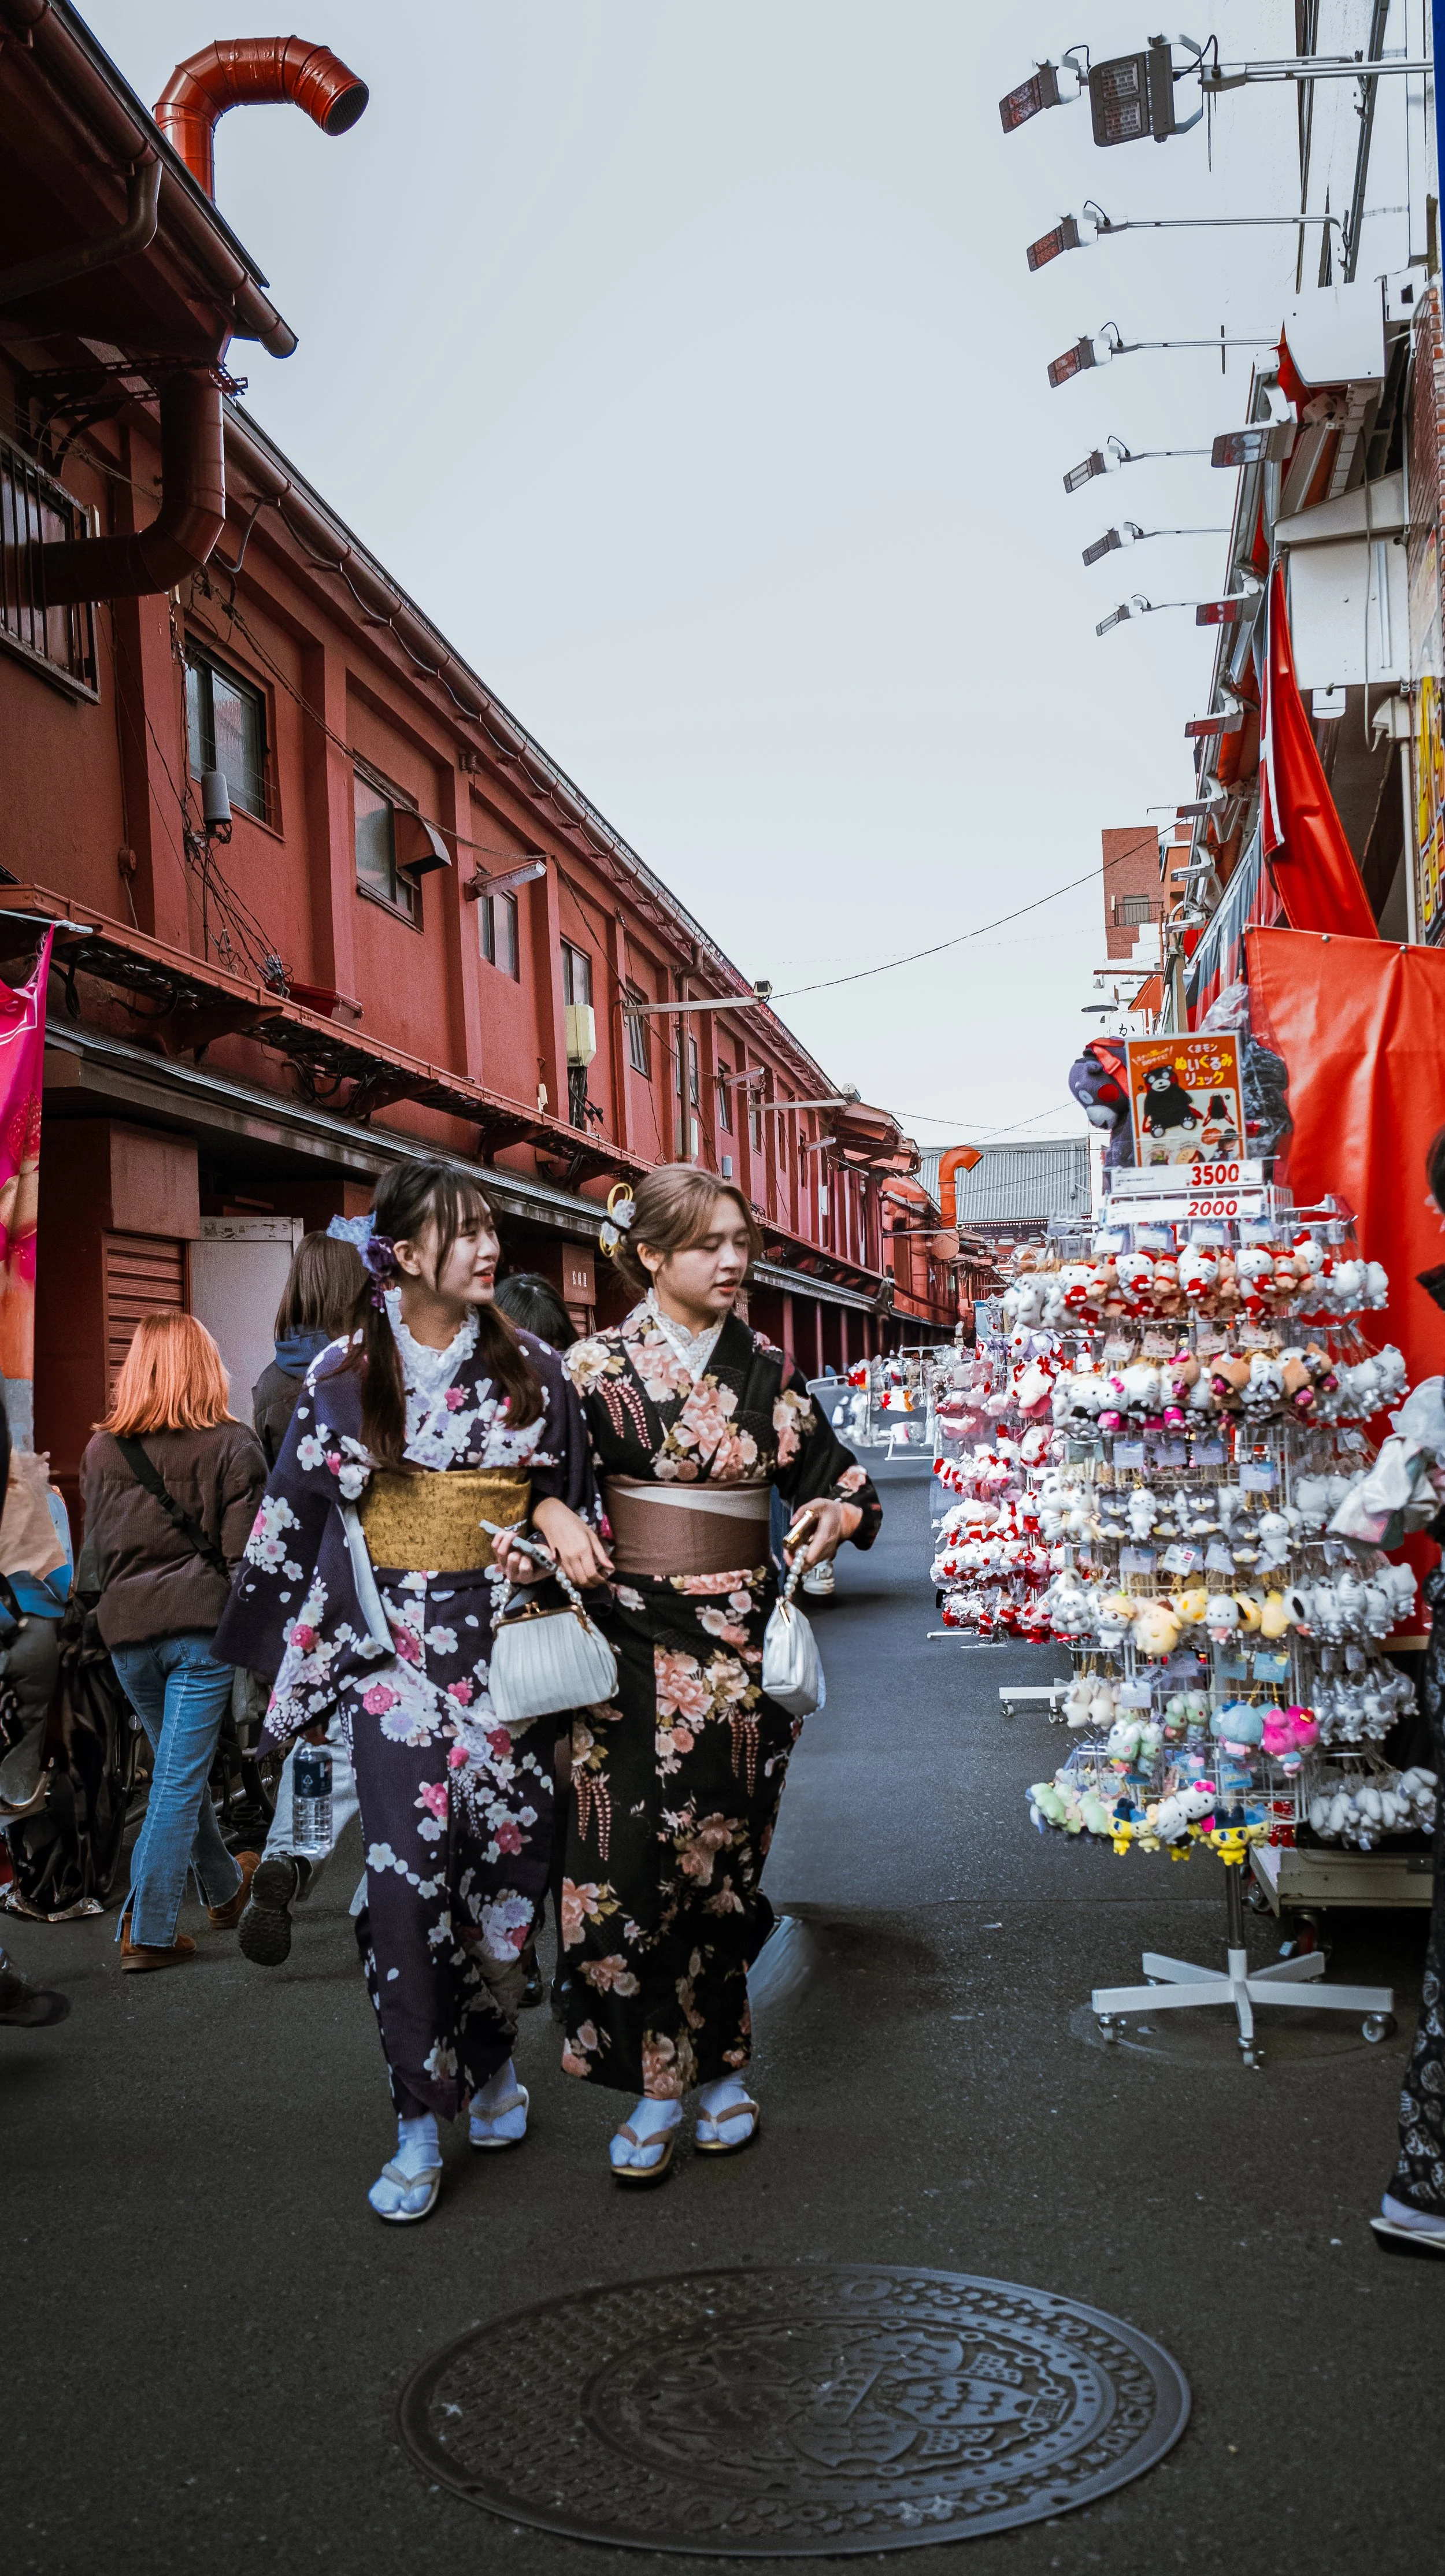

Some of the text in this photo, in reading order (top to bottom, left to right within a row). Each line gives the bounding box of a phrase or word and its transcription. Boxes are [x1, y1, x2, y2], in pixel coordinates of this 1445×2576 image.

[1118, 1022, 1135, 1037] か
[1187, 1043, 1218, 1054] くまモン
[1174, 1053, 1233, 1072] ぬいぐるみ
[1185, 1070, 1224, 1086] リュック
[1191, 1163, 1239, 1186] 3500
[1188, 1200, 1237, 1216] 2000
